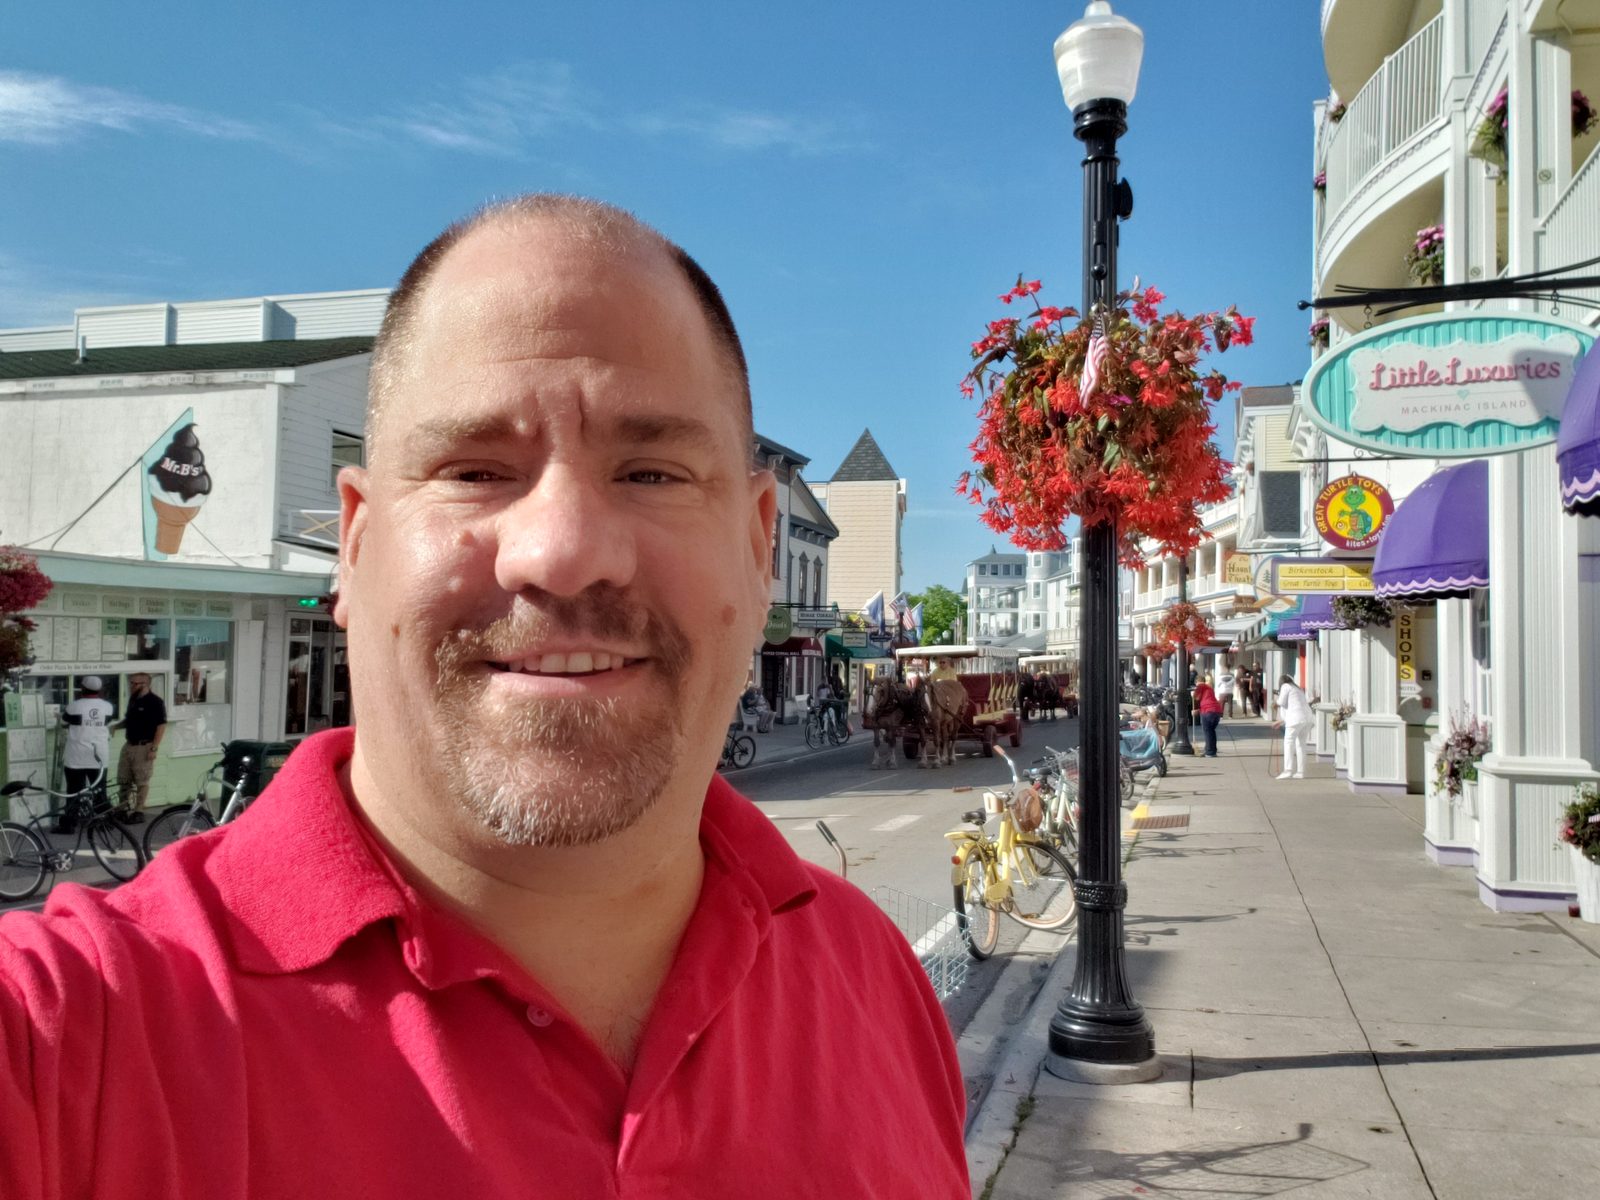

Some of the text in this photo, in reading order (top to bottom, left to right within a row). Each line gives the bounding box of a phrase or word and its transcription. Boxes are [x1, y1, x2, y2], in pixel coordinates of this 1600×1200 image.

[1369, 356, 1561, 391] Little Luxuries
[1401, 399, 1528, 415] MACKINAC ISLAND
[1315, 477, 1384, 534] GREAT TURTLE TOYS
[1288, 566, 1334, 574] Birkenstock
[1399, 614, 1412, 679] SHOPS
